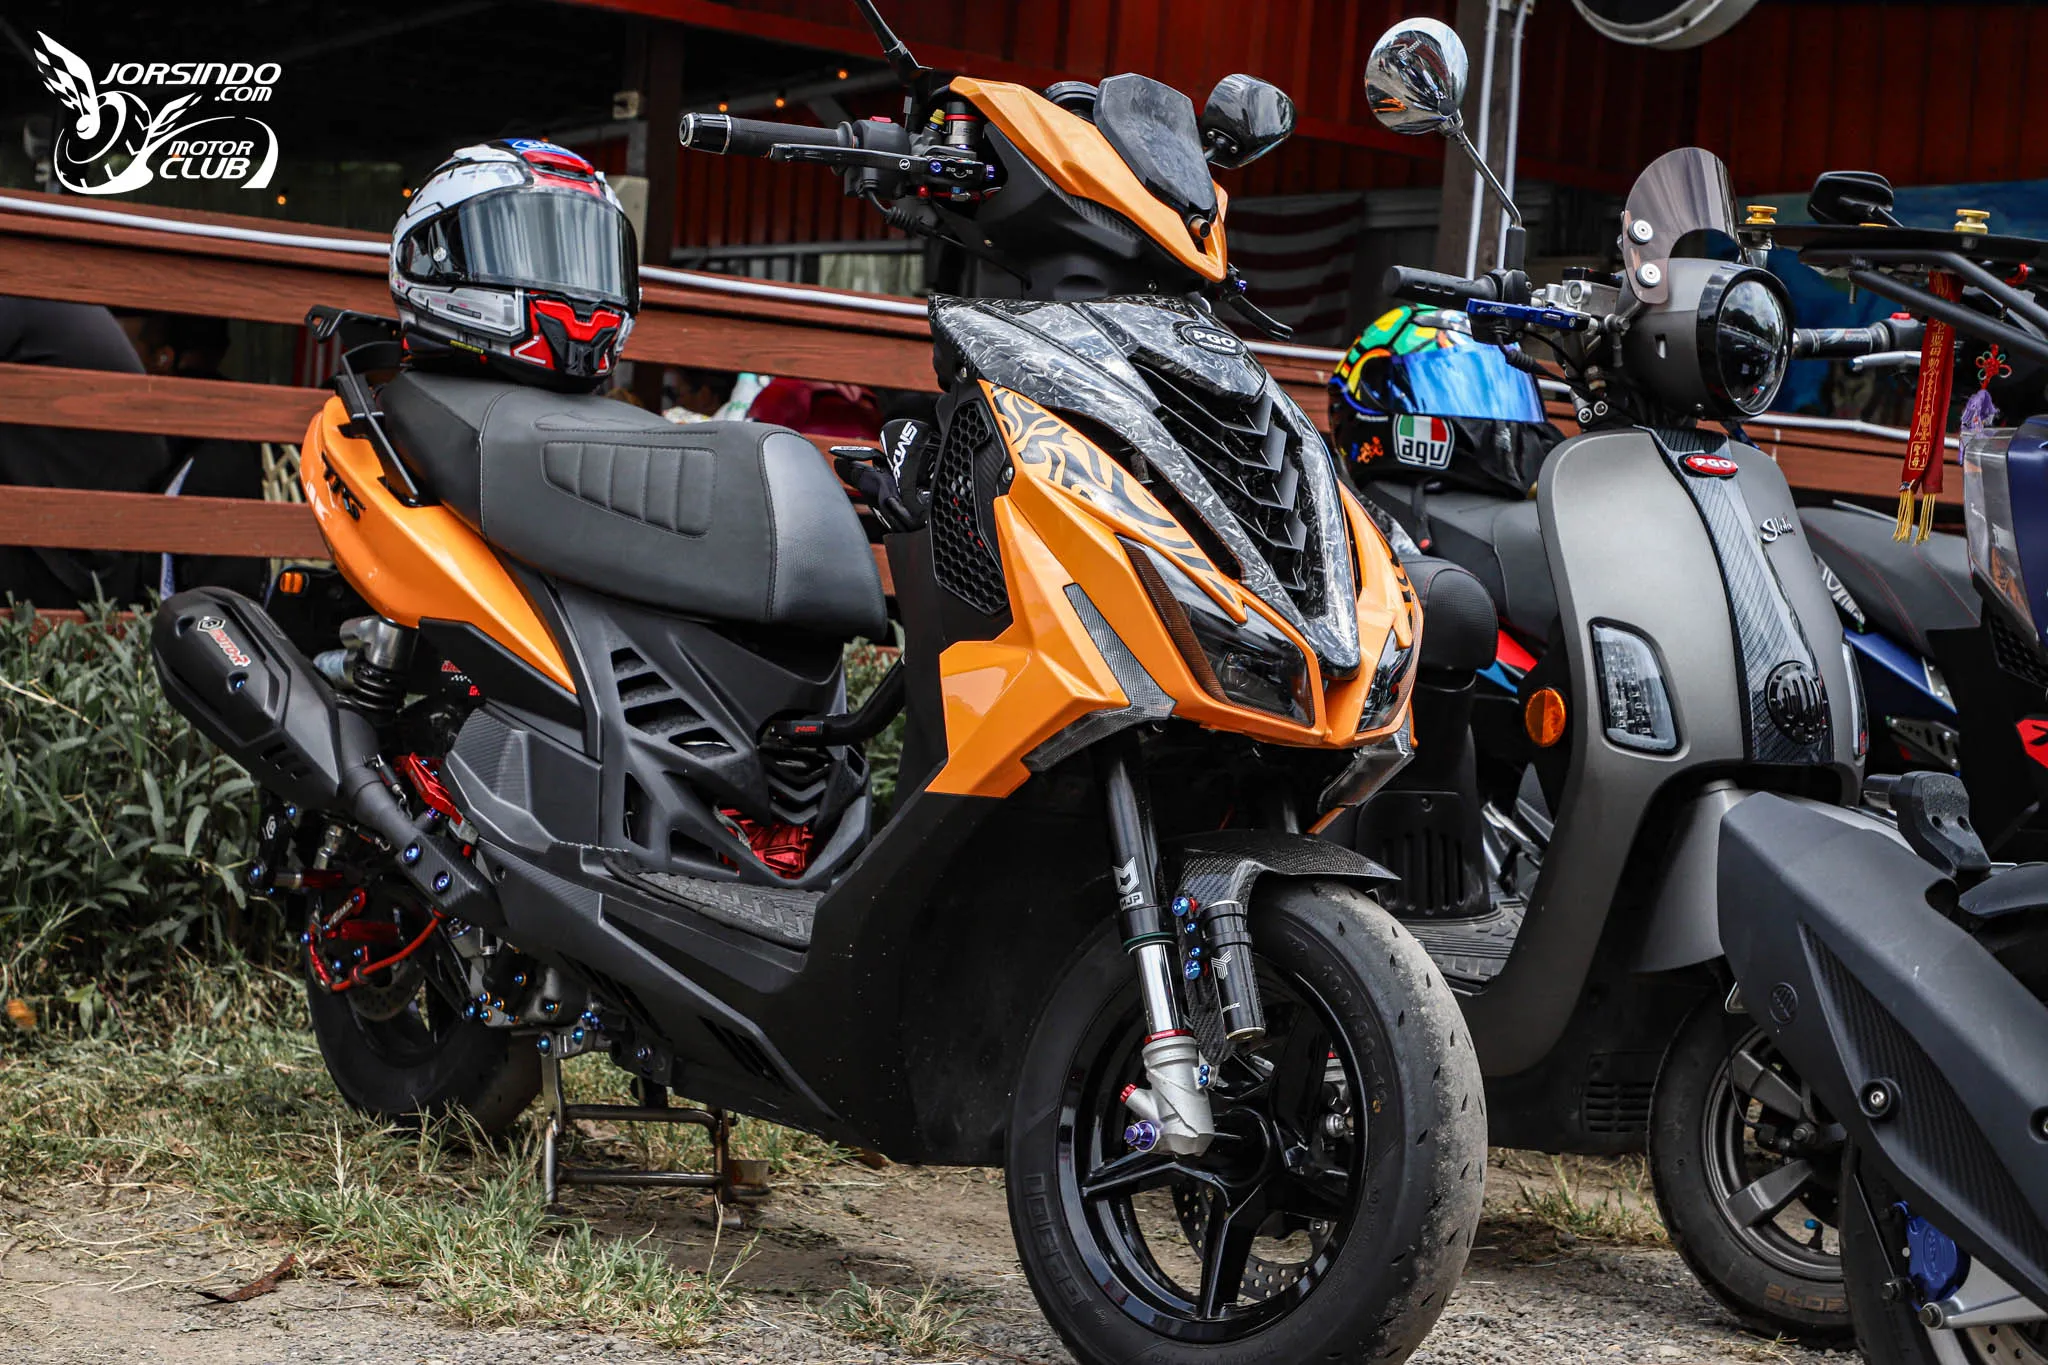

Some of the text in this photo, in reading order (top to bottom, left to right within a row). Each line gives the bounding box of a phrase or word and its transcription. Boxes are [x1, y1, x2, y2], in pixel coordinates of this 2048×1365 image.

[1192, 329, 1237, 348] PGO
[1402, 438, 1445, 464] agv
[1694, 457, 1732, 469] PGO
[1120, 894, 1142, 910] MJP
